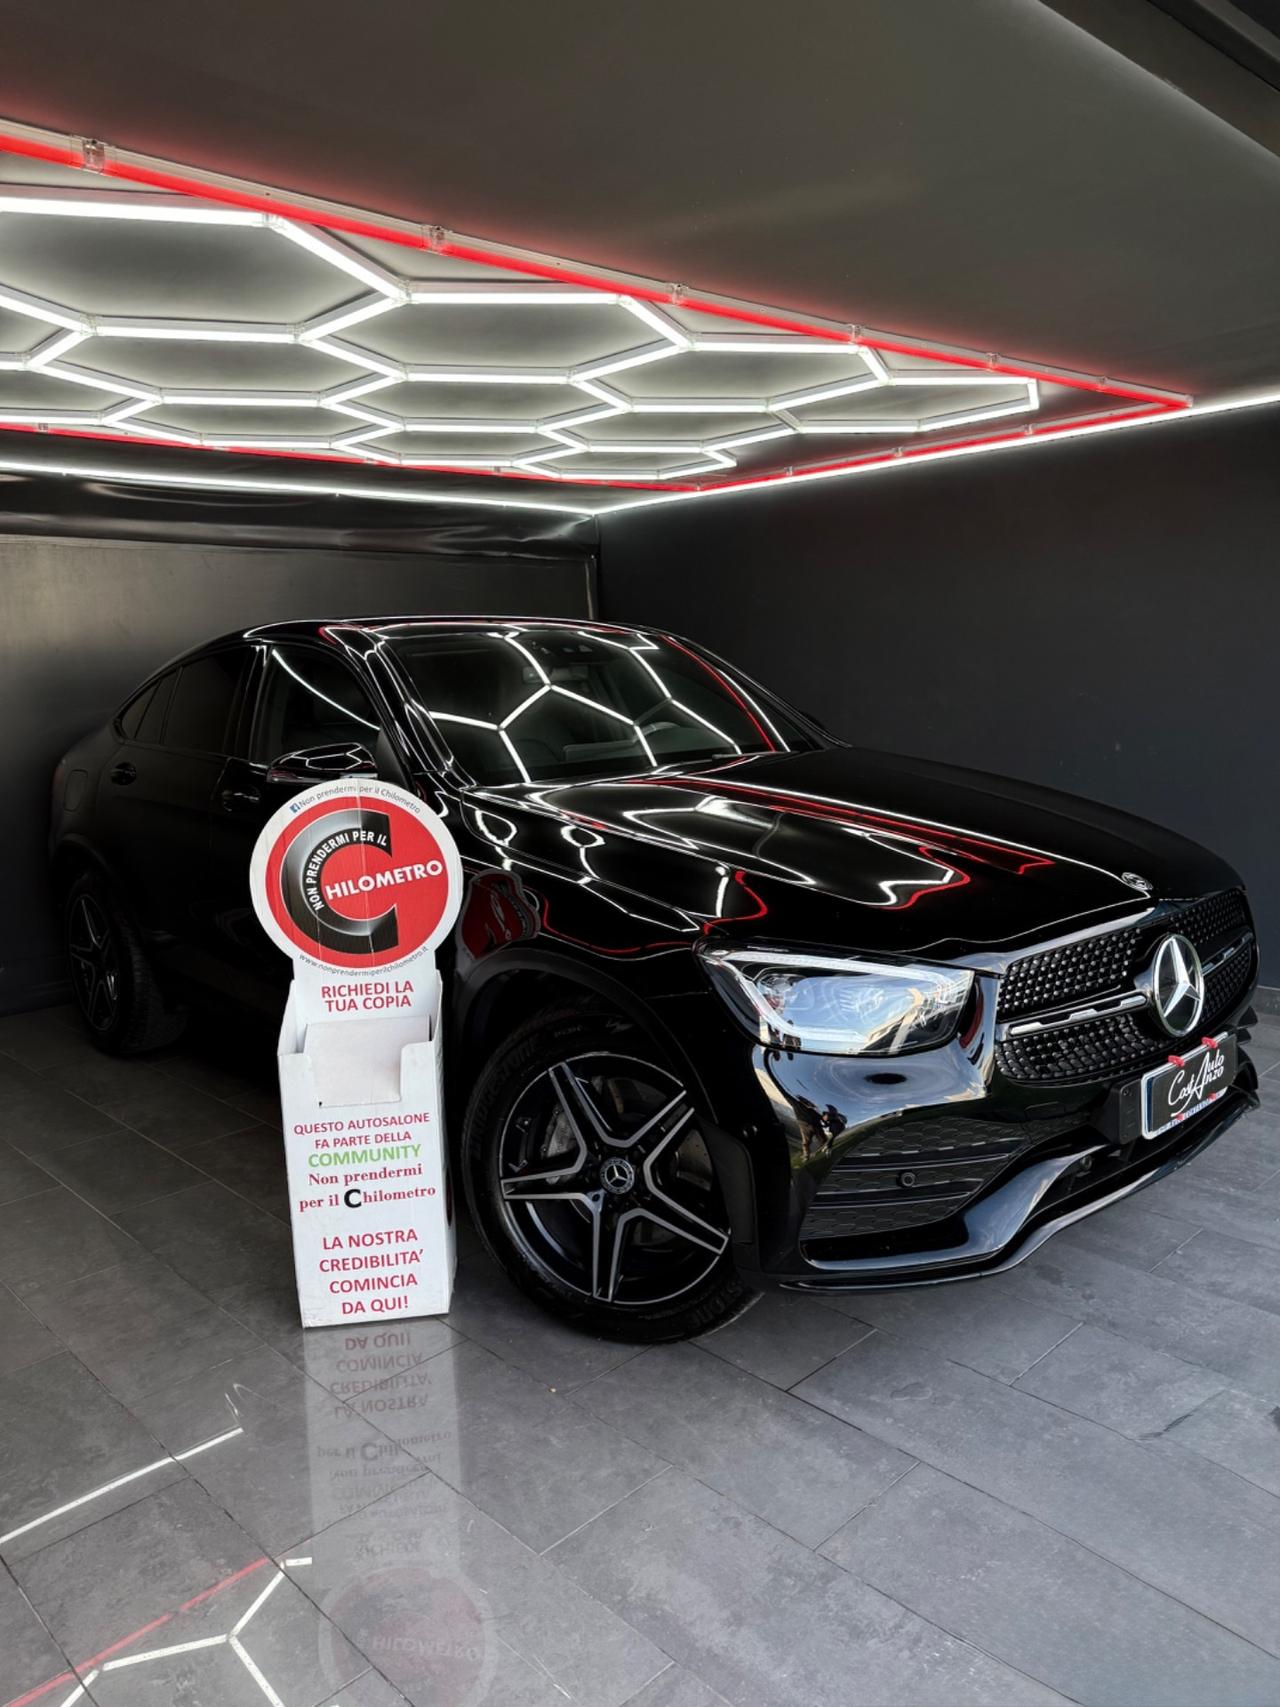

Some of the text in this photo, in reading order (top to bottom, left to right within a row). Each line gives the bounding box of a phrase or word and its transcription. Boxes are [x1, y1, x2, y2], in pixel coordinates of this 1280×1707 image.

[299, 796, 316, 808] Non
[316, 785, 357, 800] prendermi
[359, 785, 372, 794] per
[380, 787, 421, 815] Chilometro
[306, 830, 388, 911] NON PRENDERMI PER IL
[321, 980, 414, 999] RICHIEDI LA
[325, 995, 412, 1012] TUA COPIA
[293, 1112, 430, 1135] QUESTO AUTOSALONE
[315, 1131, 412, 1149] FA PARTE DELLA
[308, 1144, 422, 1168] COMMUNITY
[308, 1163, 423, 1186] Non prendermi
[299, 1188, 436, 1212] per il Chilometro
[323, 1228, 418, 1250] LA NOSTRA
[319, 1248, 424, 1272] CREDIBILITA'
[329, 1273, 418, 1294] COMINCIA
[342, 1295, 408, 1315] DA QUI!
